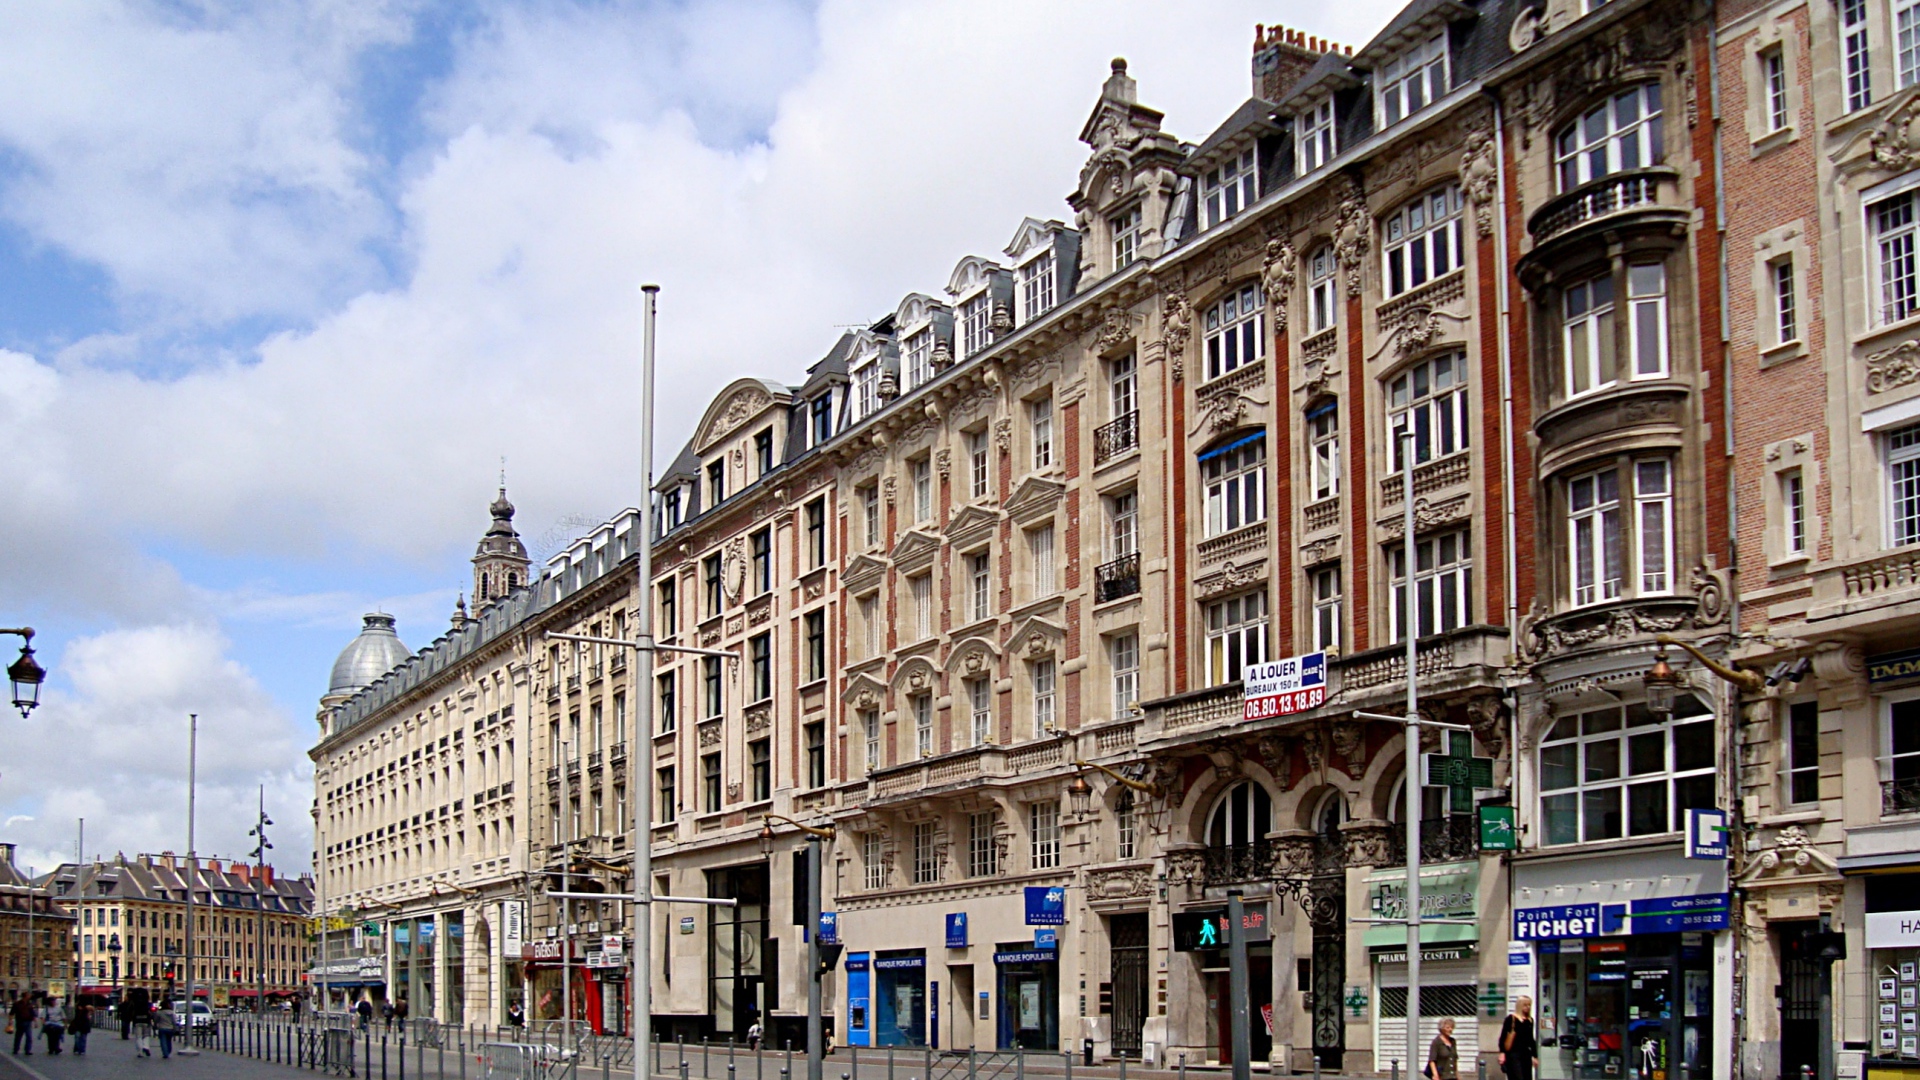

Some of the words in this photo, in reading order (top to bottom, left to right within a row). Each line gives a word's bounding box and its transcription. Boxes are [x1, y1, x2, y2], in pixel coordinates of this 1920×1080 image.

[1250, 668, 1257, 682] A
[1260, 661, 1296, 680] LOUER
[1302, 666, 1318, 676] ICADE
[1246, 682, 1278, 696] BUREAUX
[1280, 680, 1292, 690] 150
[1246, 689, 1323, 719] 06.80.13.18.89
[1517, 909, 1555, 921] Point
[1566, 907, 1596, 918] Fort
[534, 943, 561, 958] EVERSTYL
[997, 954, 1021, 963] BANQUE
[1022, 952, 1055, 961] POPULAIRE
[1424, 950, 1460, 961] CASETTA
[876, 960, 895, 968] BANQUE
[896, 959, 922, 967] POPULAIRE
